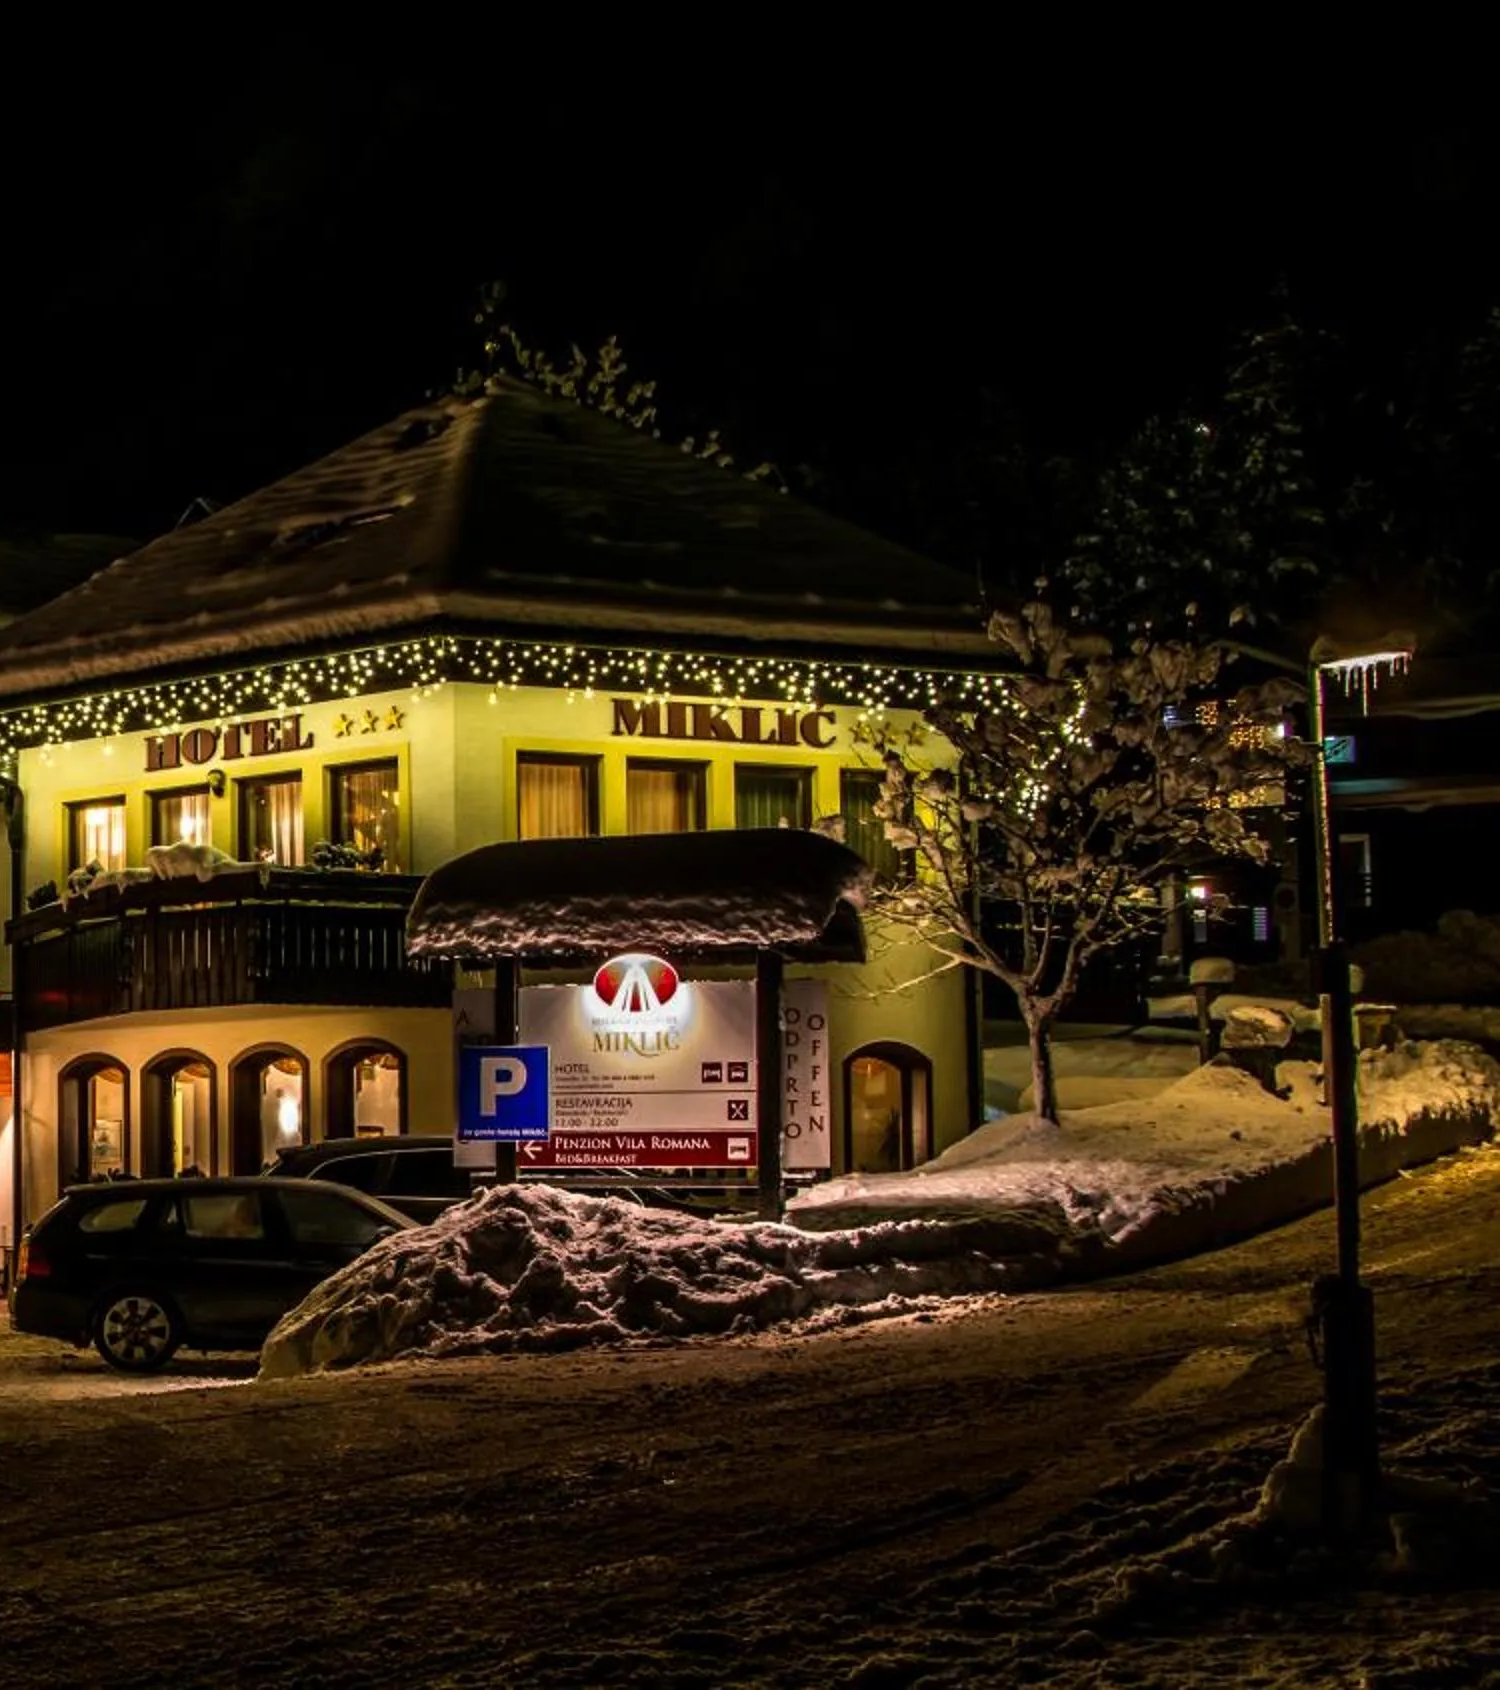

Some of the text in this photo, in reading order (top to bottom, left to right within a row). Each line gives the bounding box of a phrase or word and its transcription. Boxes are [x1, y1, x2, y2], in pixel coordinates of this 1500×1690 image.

[143, 713, 315, 772] HOTEL
[479, 1056, 528, 1117] P
[555, 1063, 590, 1074] HOTEL
[785, 1007, 802, 1139] ODPRTO
[807, 1014, 825, 1132] OFFEN
[555, 1097, 633, 1109] RESTAVRACIJA
[555, 1136, 711, 1150] PENZION VILA ROMANA
